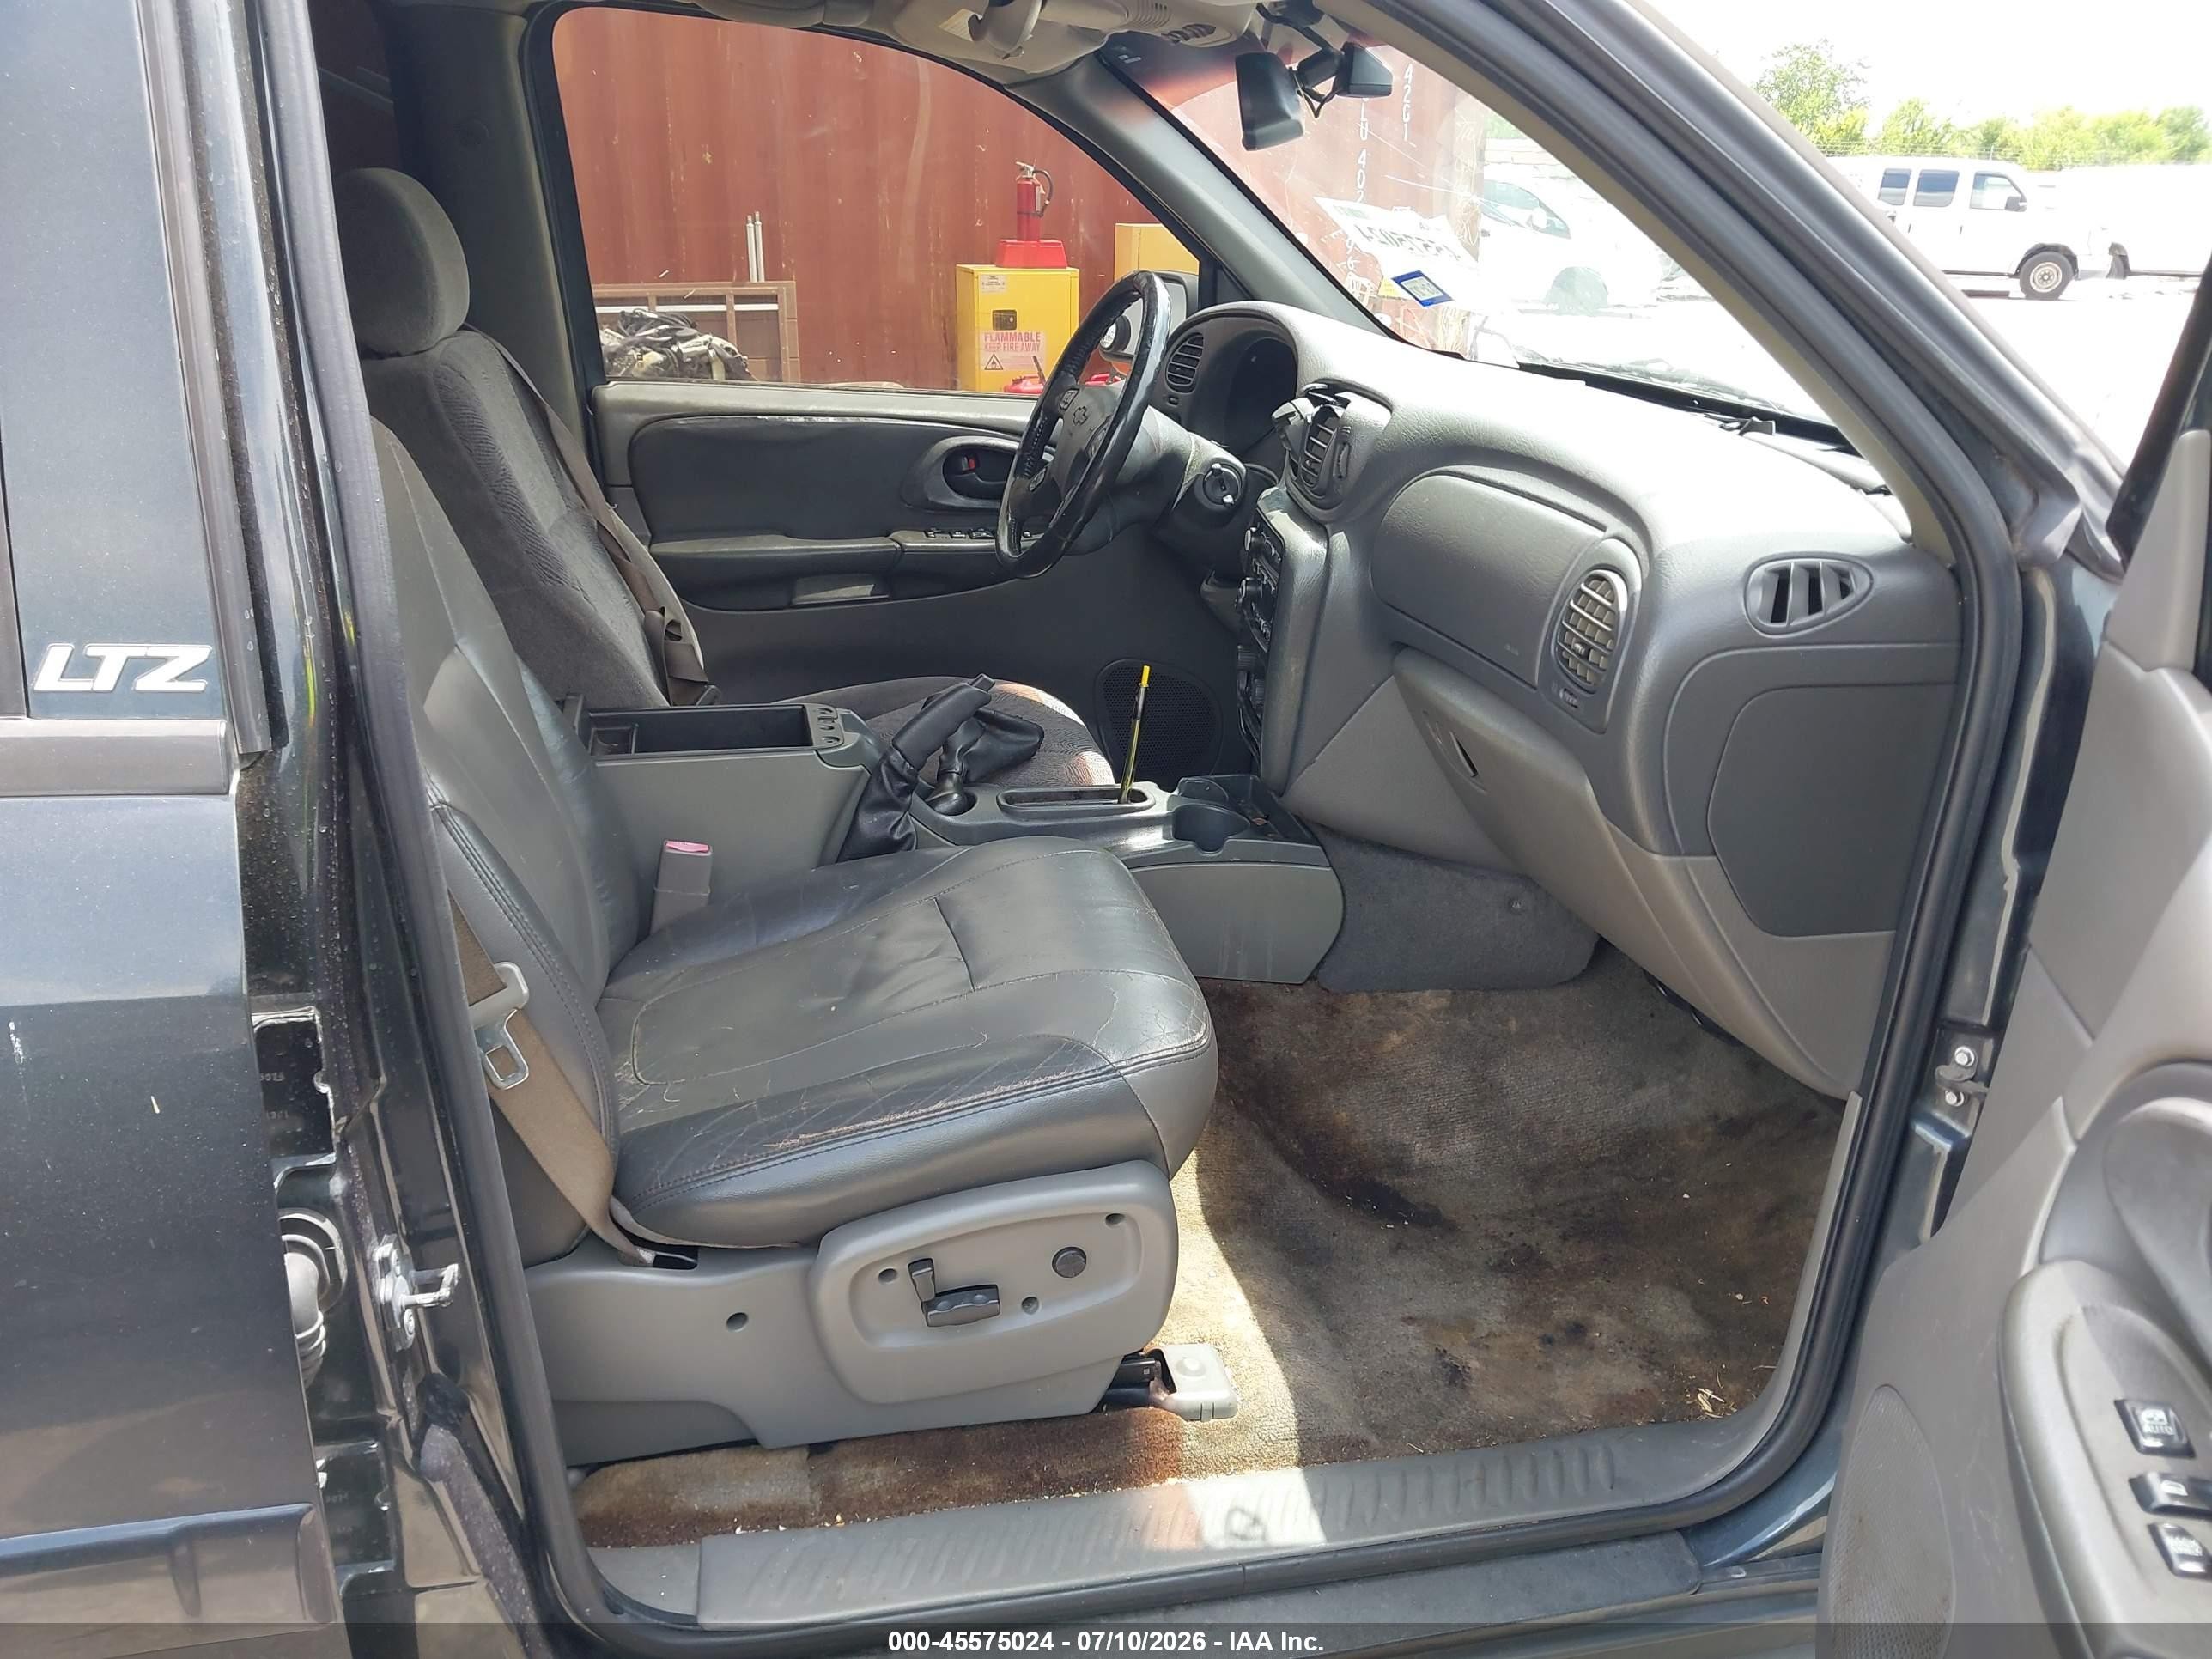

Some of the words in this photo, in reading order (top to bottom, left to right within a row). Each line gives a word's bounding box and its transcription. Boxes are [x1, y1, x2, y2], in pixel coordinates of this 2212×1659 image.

[984, 331, 1041, 343] FLAMMABLE
[1003, 343, 1019, 353] FIRE
[1021, 343, 1041, 353] AWAY
[33, 642, 212, 693] LTZ
[2142, 1424, 2175, 1436] AUTO
